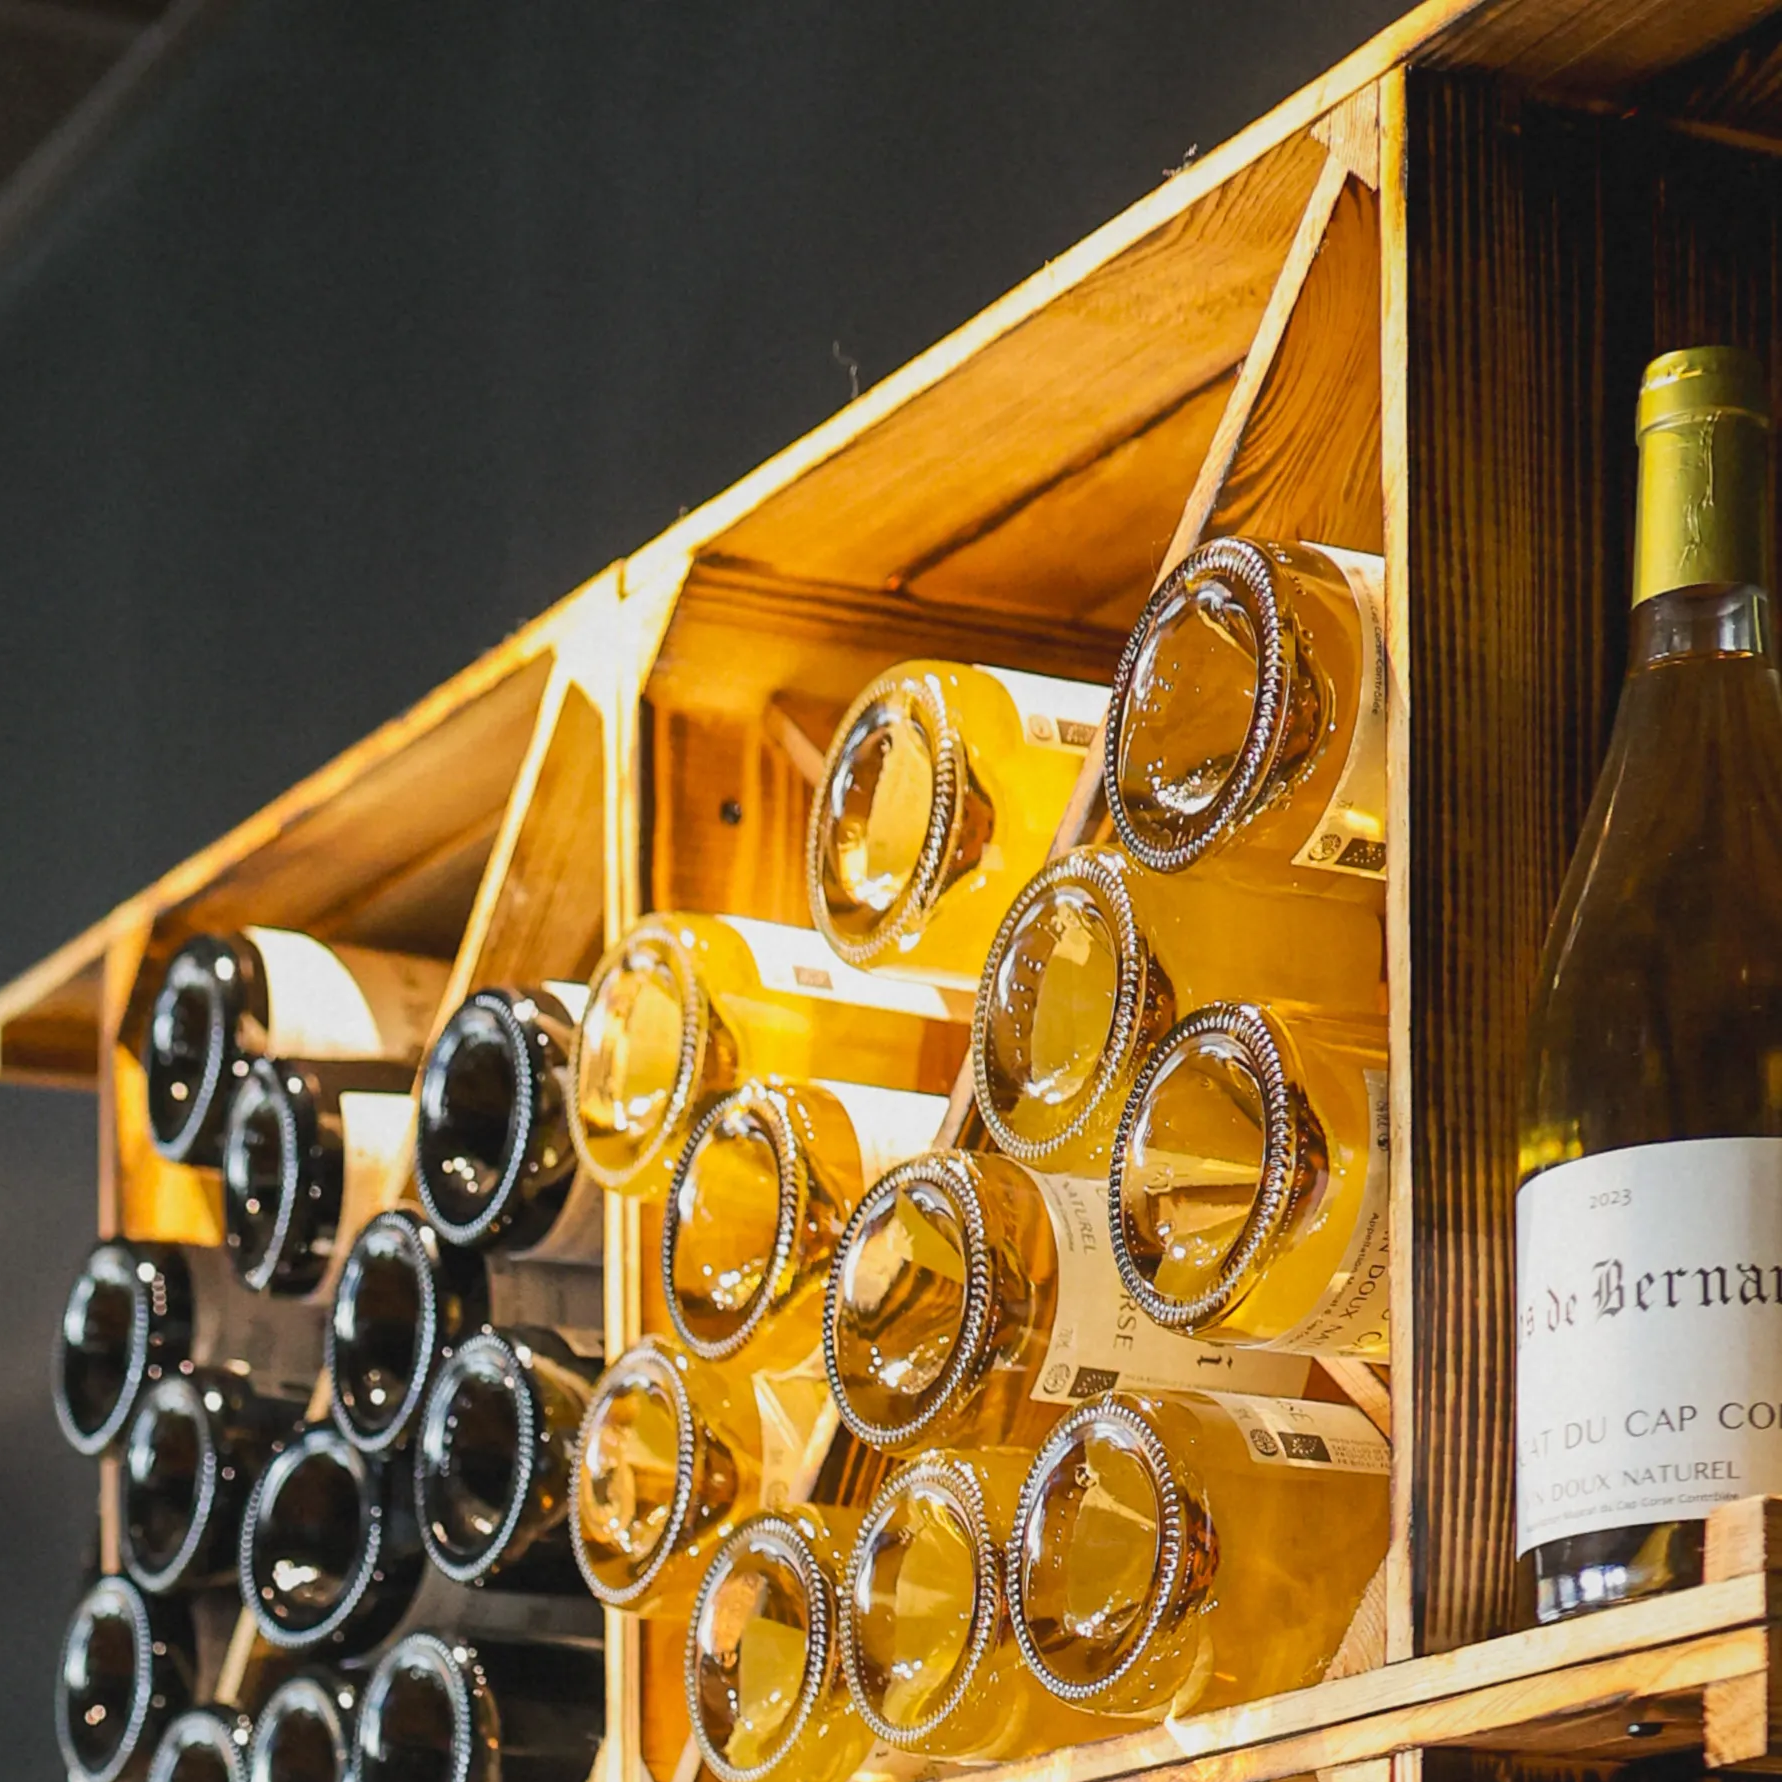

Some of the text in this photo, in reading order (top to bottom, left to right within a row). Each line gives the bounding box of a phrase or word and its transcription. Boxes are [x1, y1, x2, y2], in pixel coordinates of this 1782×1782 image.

[1589, 1188, 1633, 1210] 2023
[1339, 1264, 1386, 1320] DOUX
[1564, 1416, 1608, 1450] DU
[1624, 1404, 1698, 1438] CAP
[1718, 1401, 1782, 1431] CO
[1551, 1473, 1612, 1502] DOUX
[1622, 1460, 1741, 1487] NATUREL
